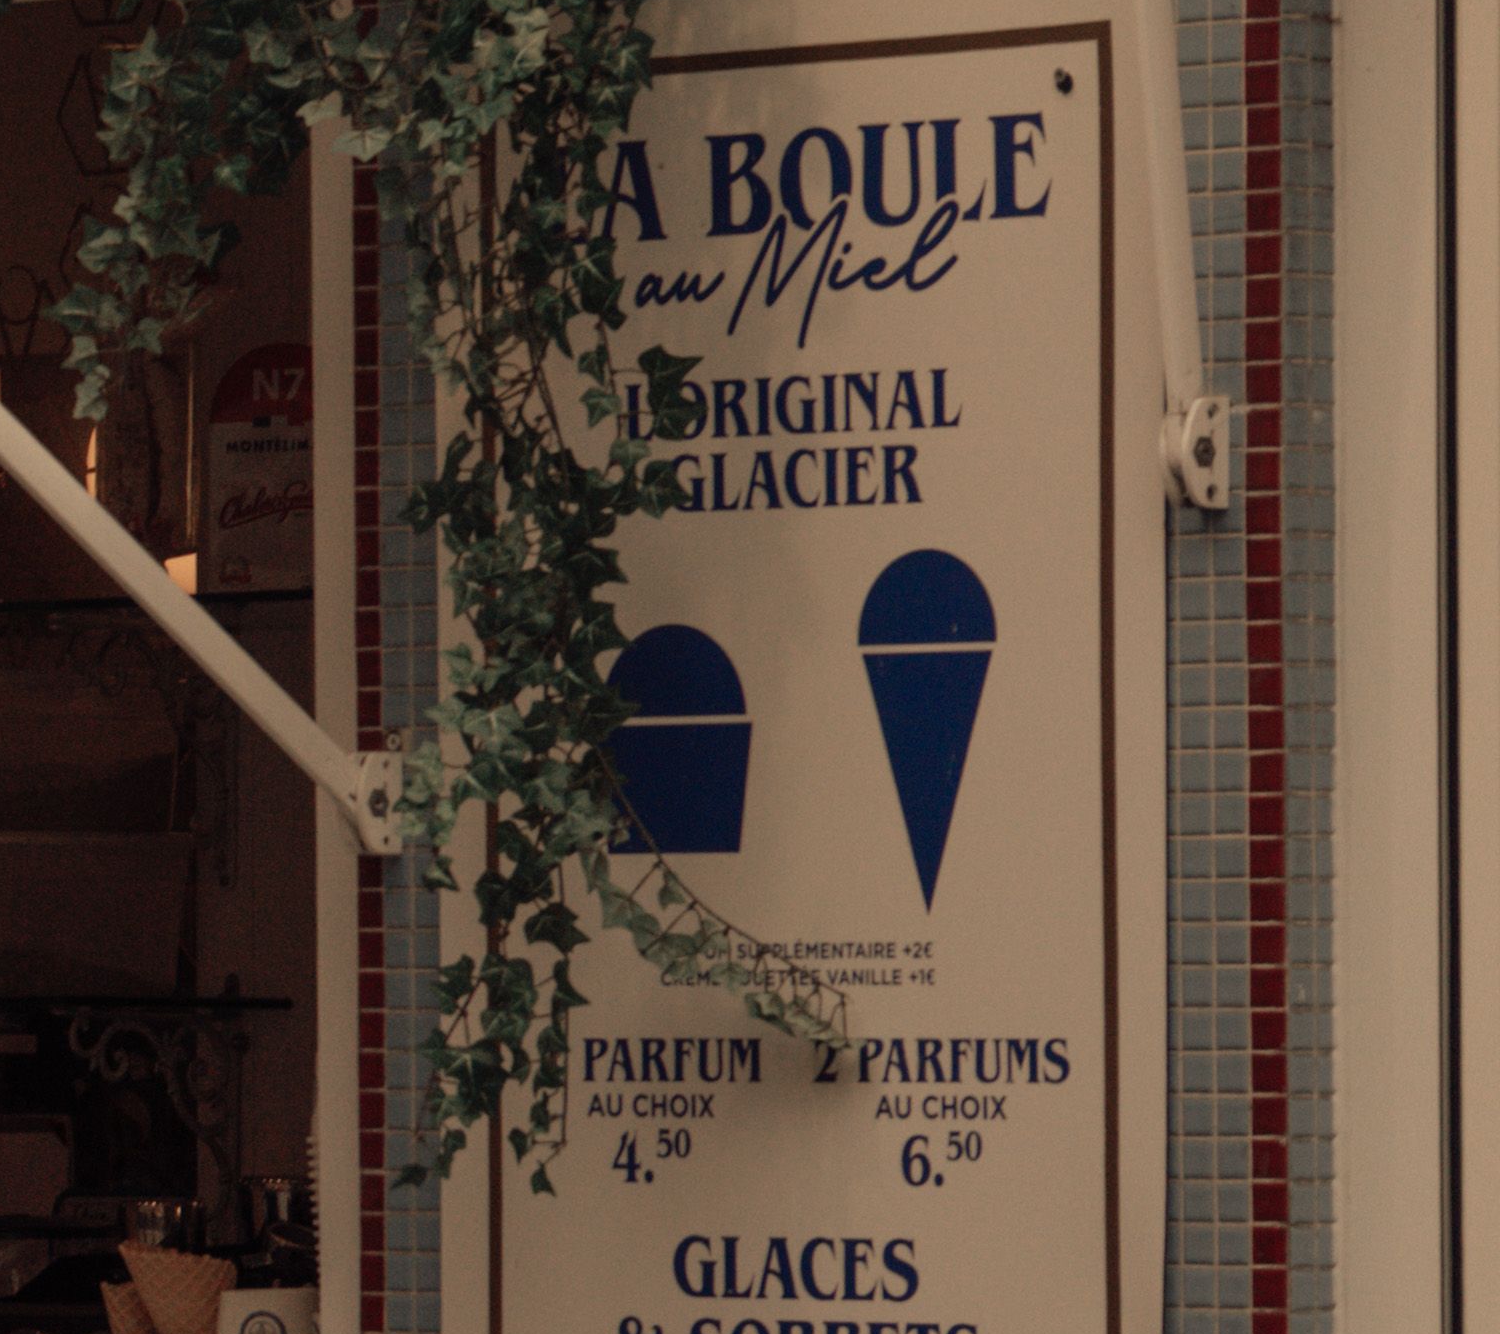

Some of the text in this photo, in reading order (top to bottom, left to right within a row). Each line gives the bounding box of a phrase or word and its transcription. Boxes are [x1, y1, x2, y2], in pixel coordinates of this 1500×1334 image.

[568, 113, 1052, 243] A BOULE
[635, 200, 958, 348] au Miel
[252, 368, 306, 401] N7
[672, 445, 923, 513] GLACIER
[584, 1038, 761, 1083] PARFUM
[813, 1038, 1072, 1085] 2 PARFUMS
[587, 1093, 715, 1119] AU CHOIX
[875, 1094, 1007, 1121] AU CHOIX
[611, 1128, 693, 1184] 4.50
[899, 1130, 984, 1188] 6.50
[671, 1233, 920, 1304] GLACES
